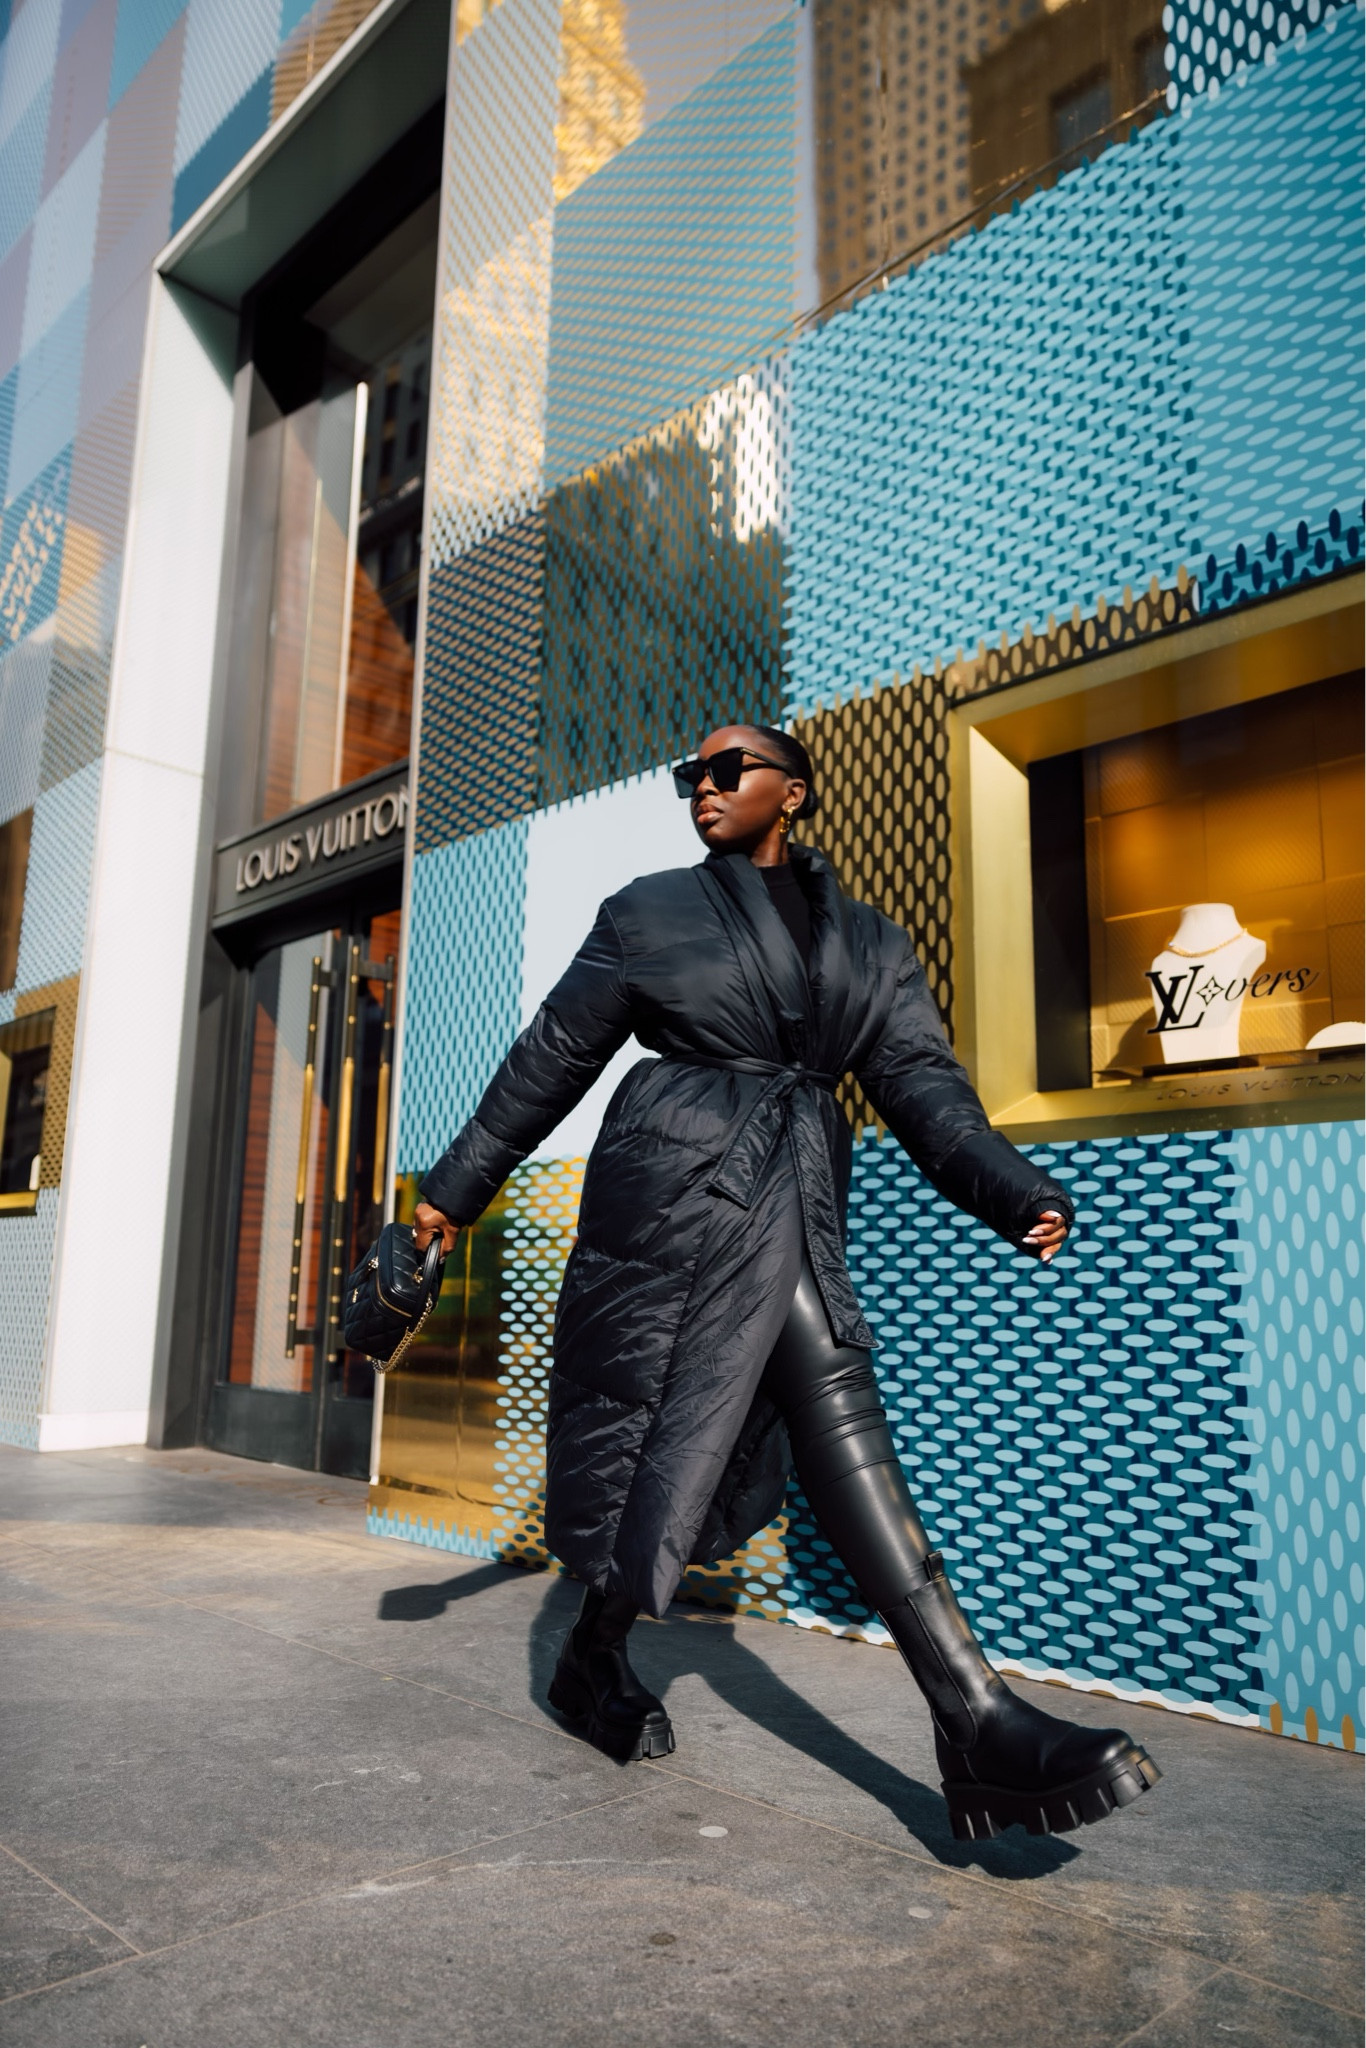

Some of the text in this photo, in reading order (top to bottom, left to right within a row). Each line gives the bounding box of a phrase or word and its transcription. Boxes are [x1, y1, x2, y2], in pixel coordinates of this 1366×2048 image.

[236, 834, 300, 891] LOUIS
[1157, 1073, 1364, 1100] LOUIS VUITTON
